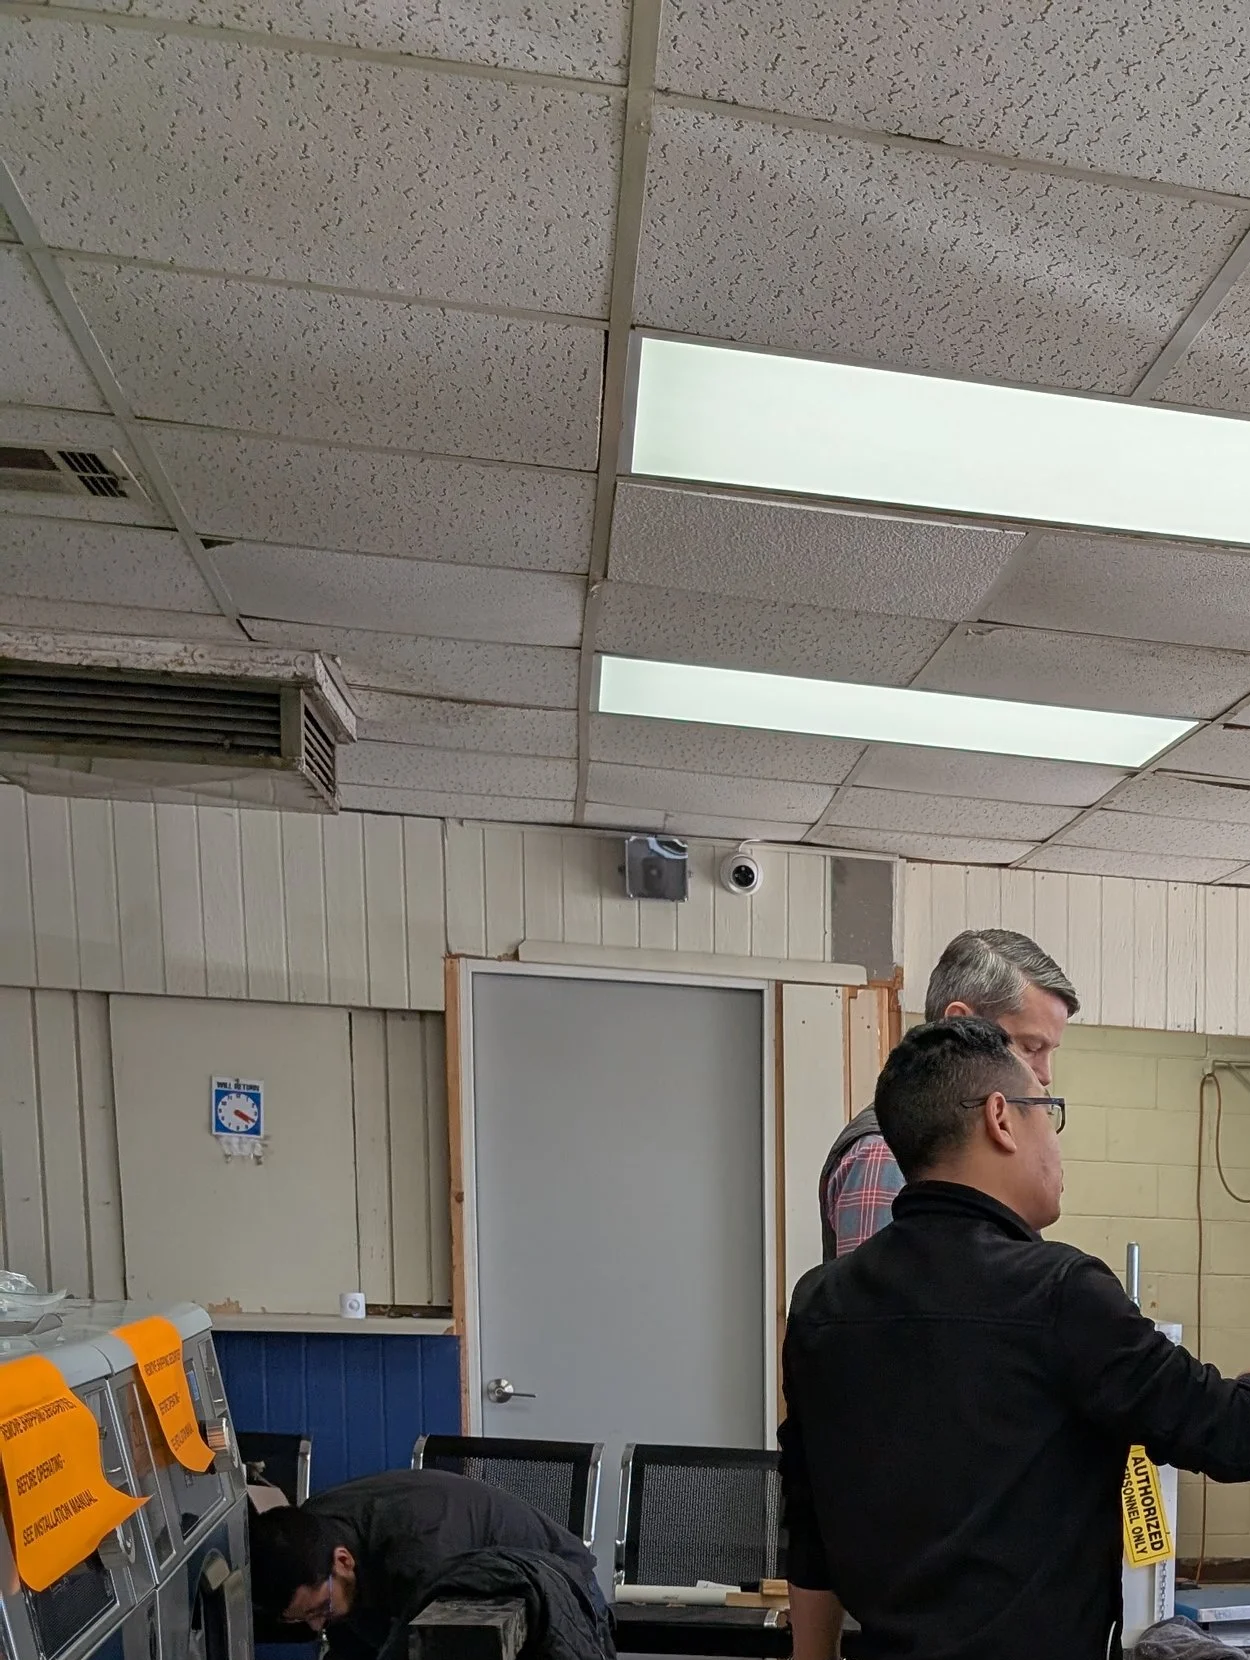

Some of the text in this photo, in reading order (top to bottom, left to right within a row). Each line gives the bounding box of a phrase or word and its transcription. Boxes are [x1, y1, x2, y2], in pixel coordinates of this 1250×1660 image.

[16, 1468, 38, 1496] BEFORE
[1131, 1456, 1165, 1552] AUTHORIZED
[23, 1488, 98, 1547] SEE INSTALLATION MANUAL
[1131, 1526, 1148, 1555] ONLY
